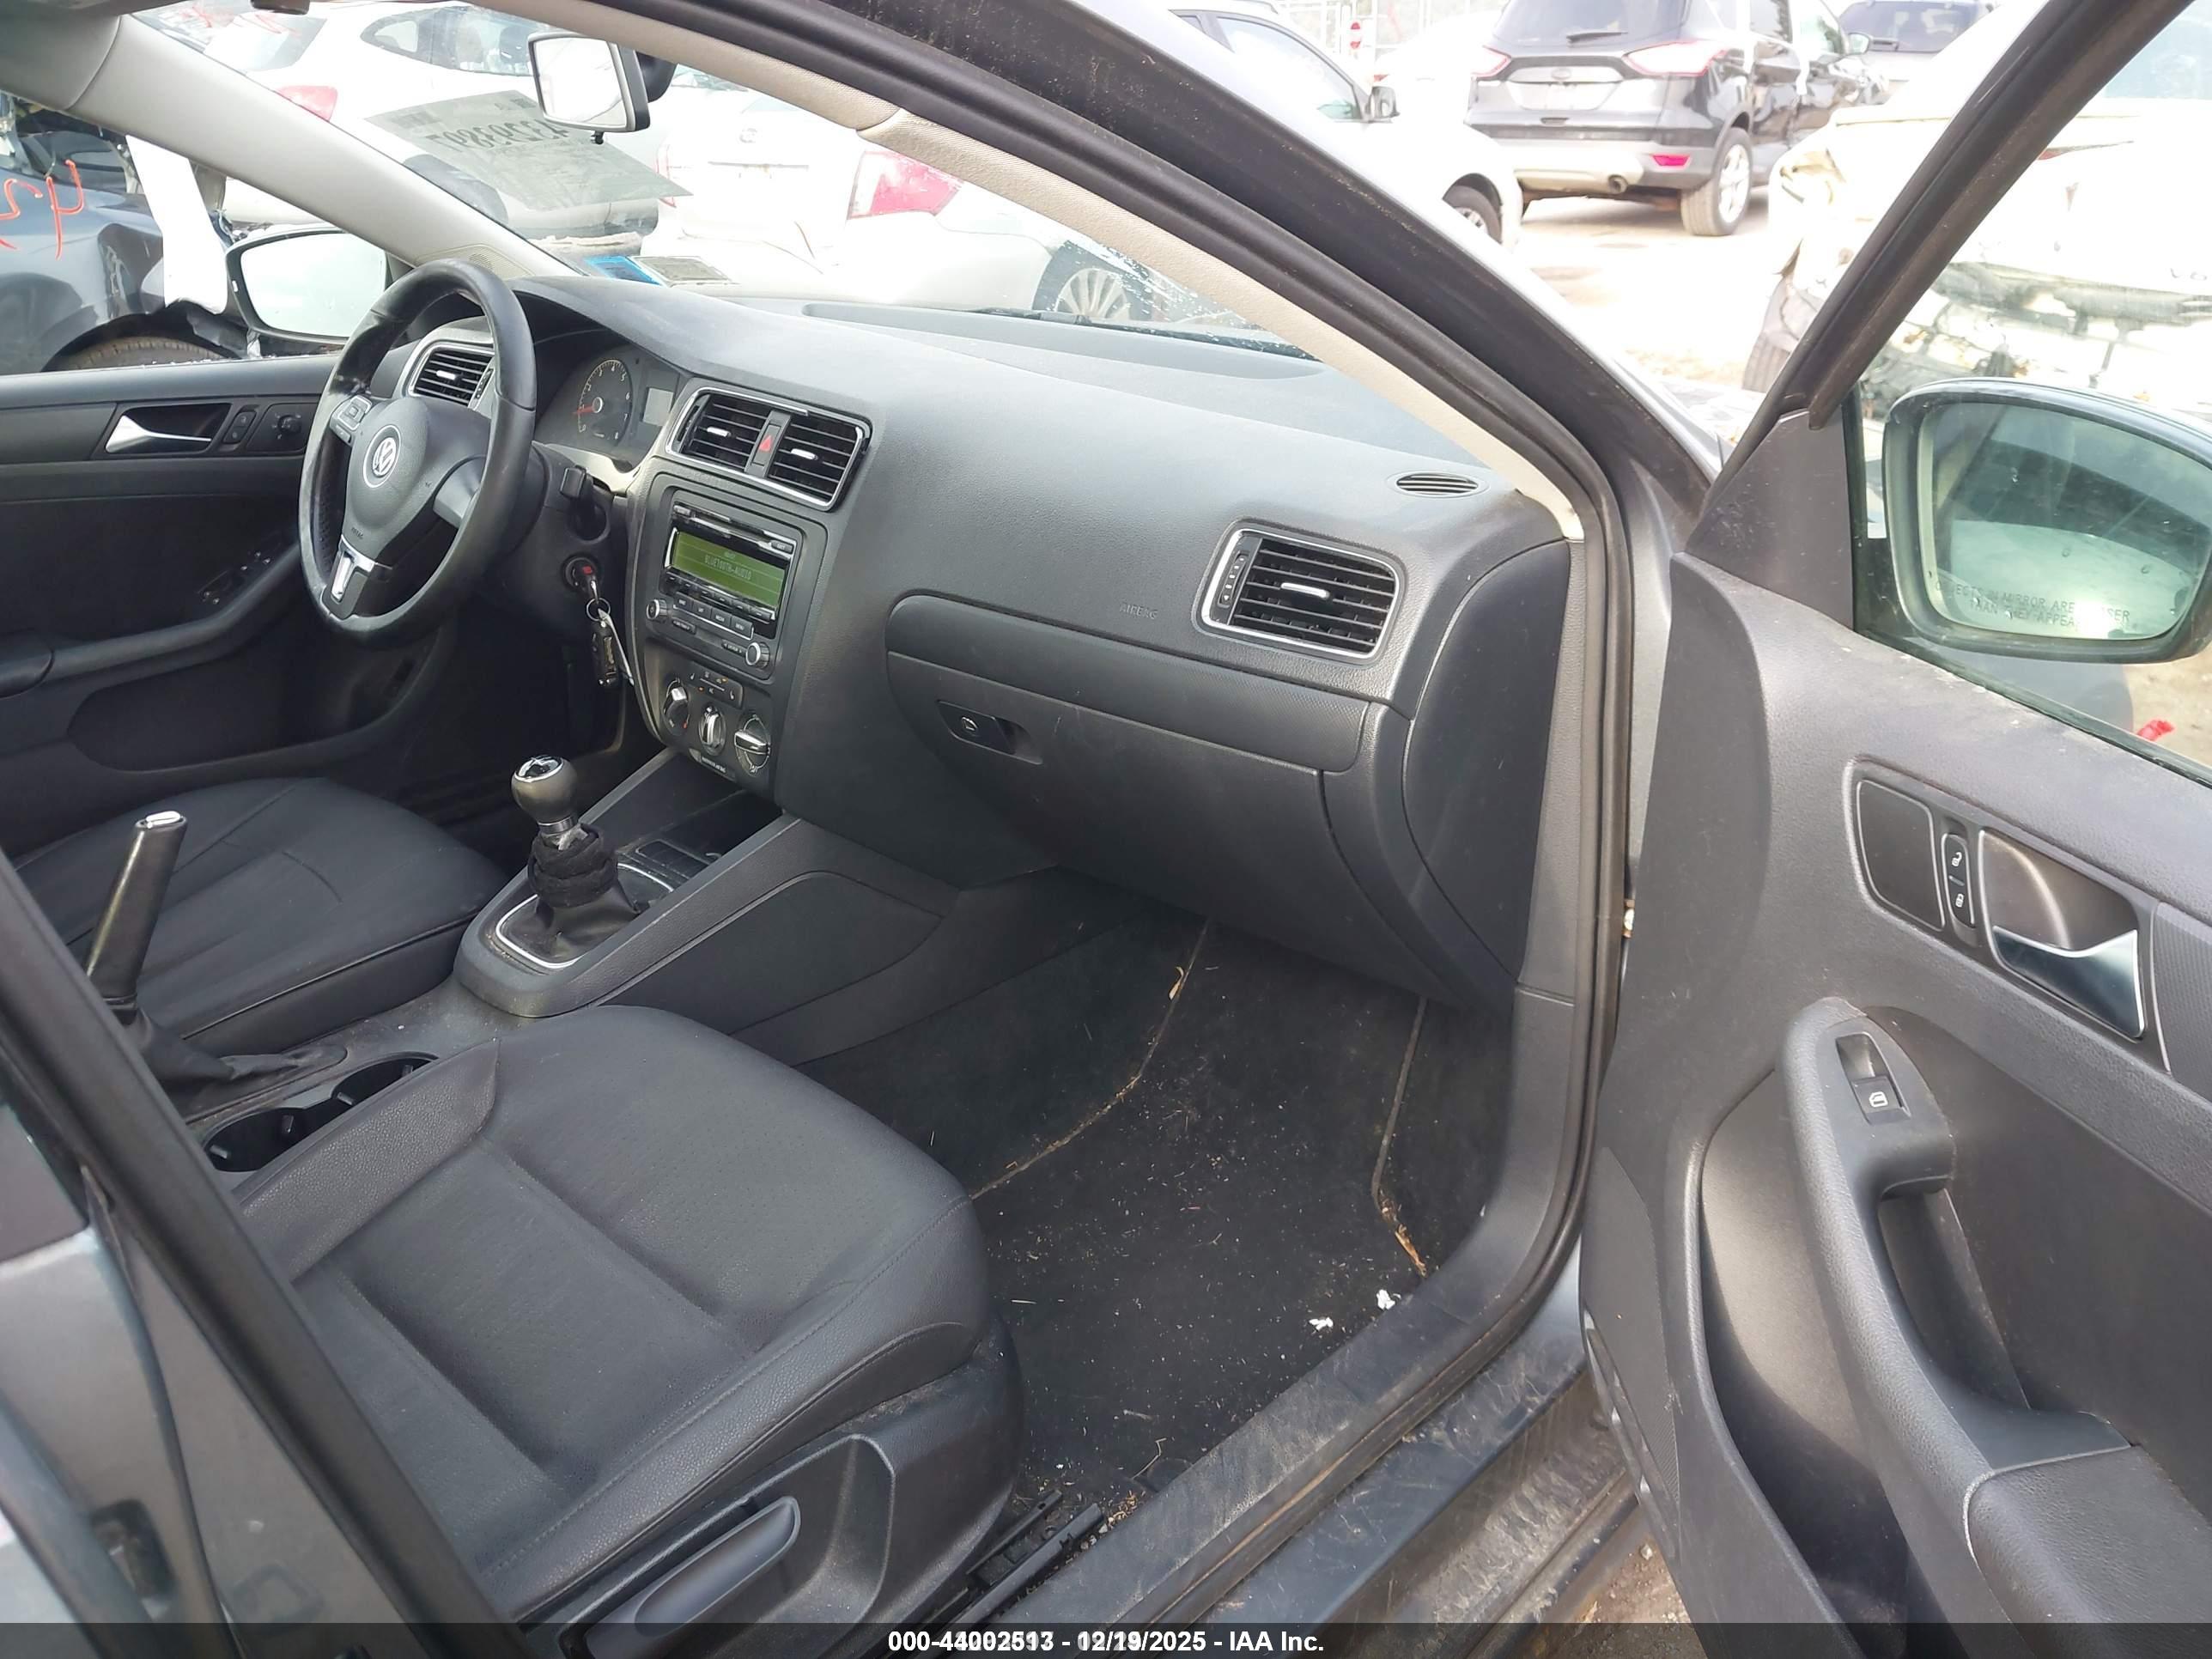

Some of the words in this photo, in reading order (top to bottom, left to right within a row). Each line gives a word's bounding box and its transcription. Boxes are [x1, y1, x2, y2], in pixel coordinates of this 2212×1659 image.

[2003, 592, 2045, 608] MIRROR
[2051, 599, 2075, 613] ARE
[2037, 611, 2078, 628] APPEA
